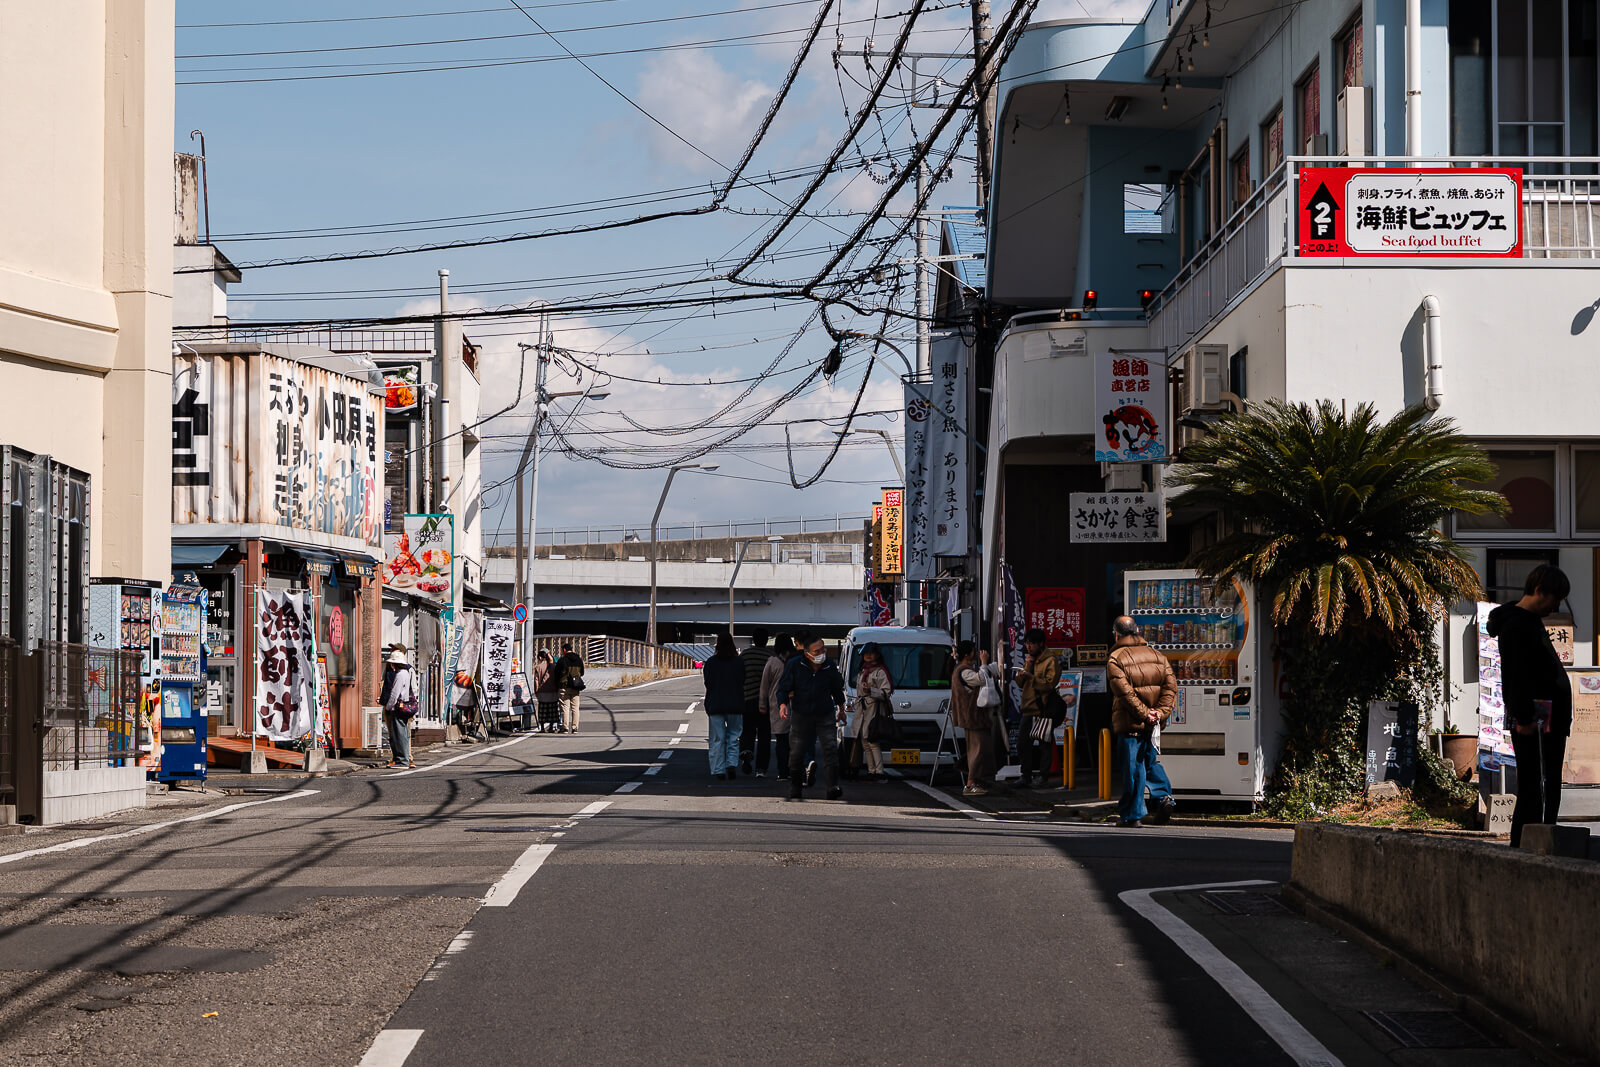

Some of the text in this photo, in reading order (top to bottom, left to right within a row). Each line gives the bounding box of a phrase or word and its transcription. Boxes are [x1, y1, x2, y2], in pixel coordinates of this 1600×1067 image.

[1357, 188, 1505, 200] 刺身、フライ、煮魚、焼魚、あら汁
[1356, 205, 1507, 231] 海鮮ビュッフェ
[1381, 235, 1482, 248] Seafood buffet
[1112, 359, 1149, 377] 漁師
[1111, 379, 1150, 393] 直営店
[260, 598, 301, 733] 漁師汁
[1382, 721, 1403, 769] 地魚
[1366, 749, 1378, 783] 専門店
